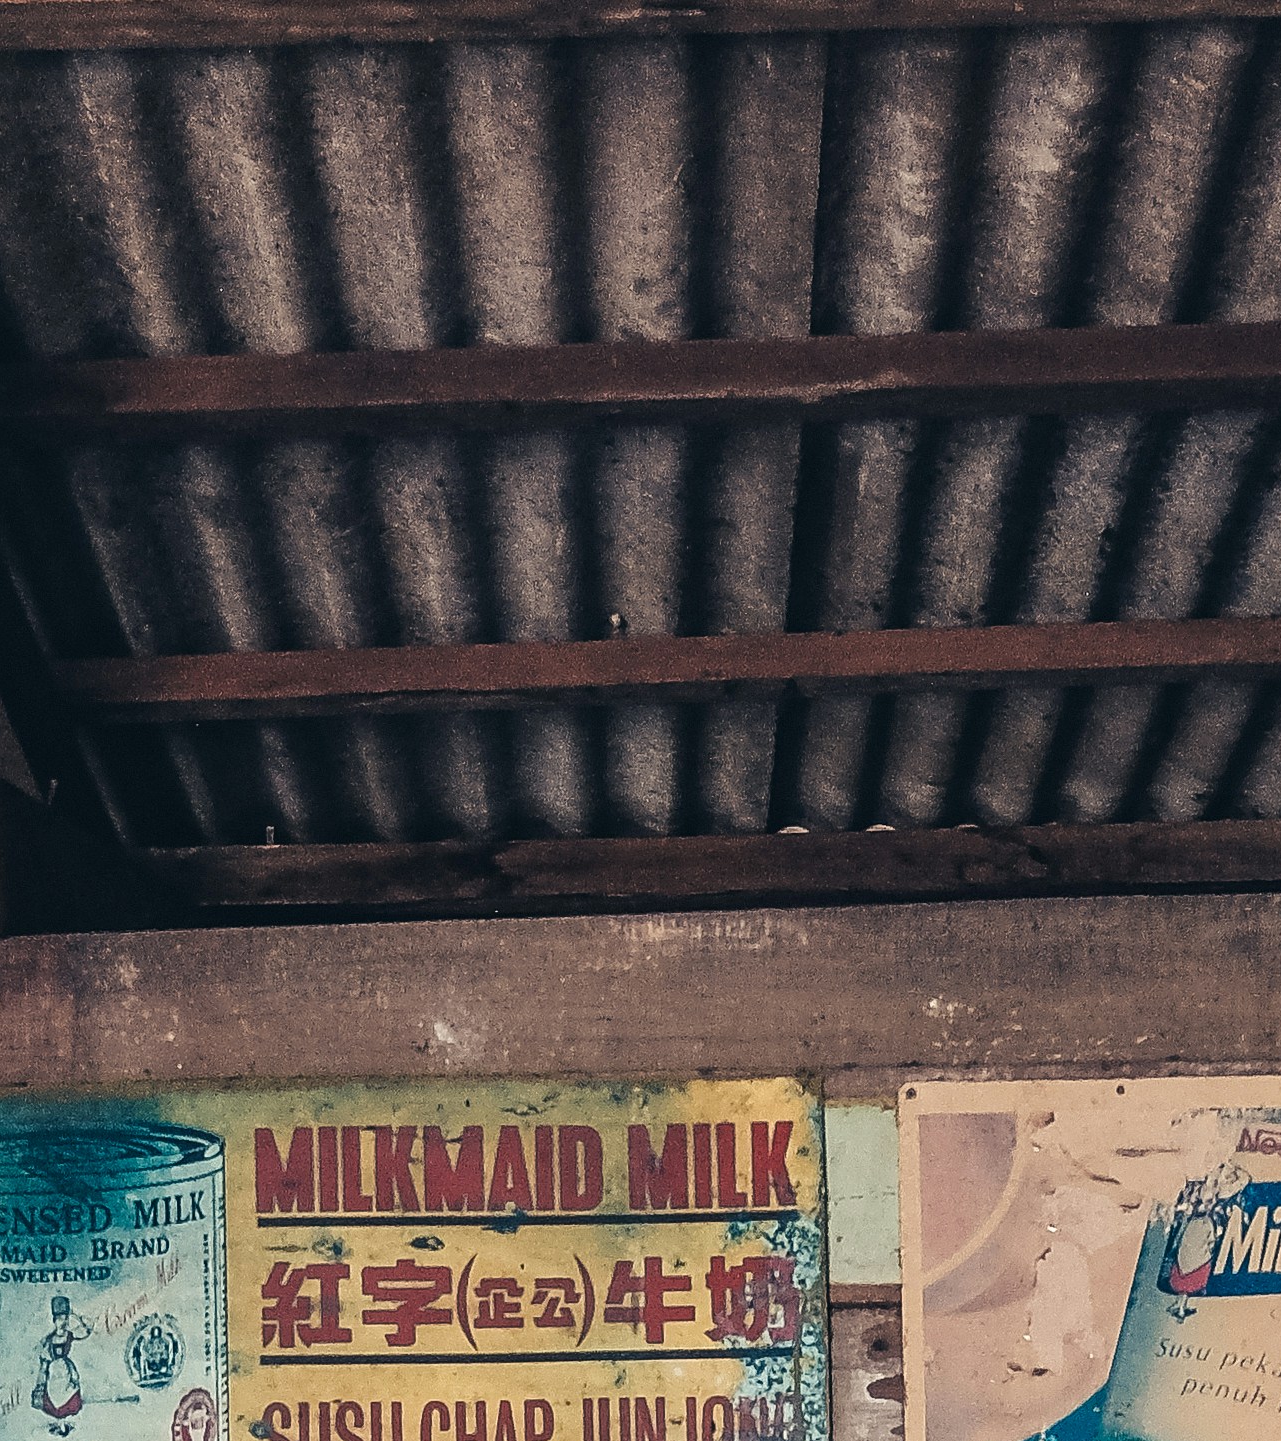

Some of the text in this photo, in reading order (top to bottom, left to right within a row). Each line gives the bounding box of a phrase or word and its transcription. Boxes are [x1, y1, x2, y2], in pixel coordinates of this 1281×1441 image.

[254, 1121, 798, 1213] MILKMAID MILK
[133, 1191, 207, 1230] MILK
[0, 1265, 111, 1284] SWEETENED
